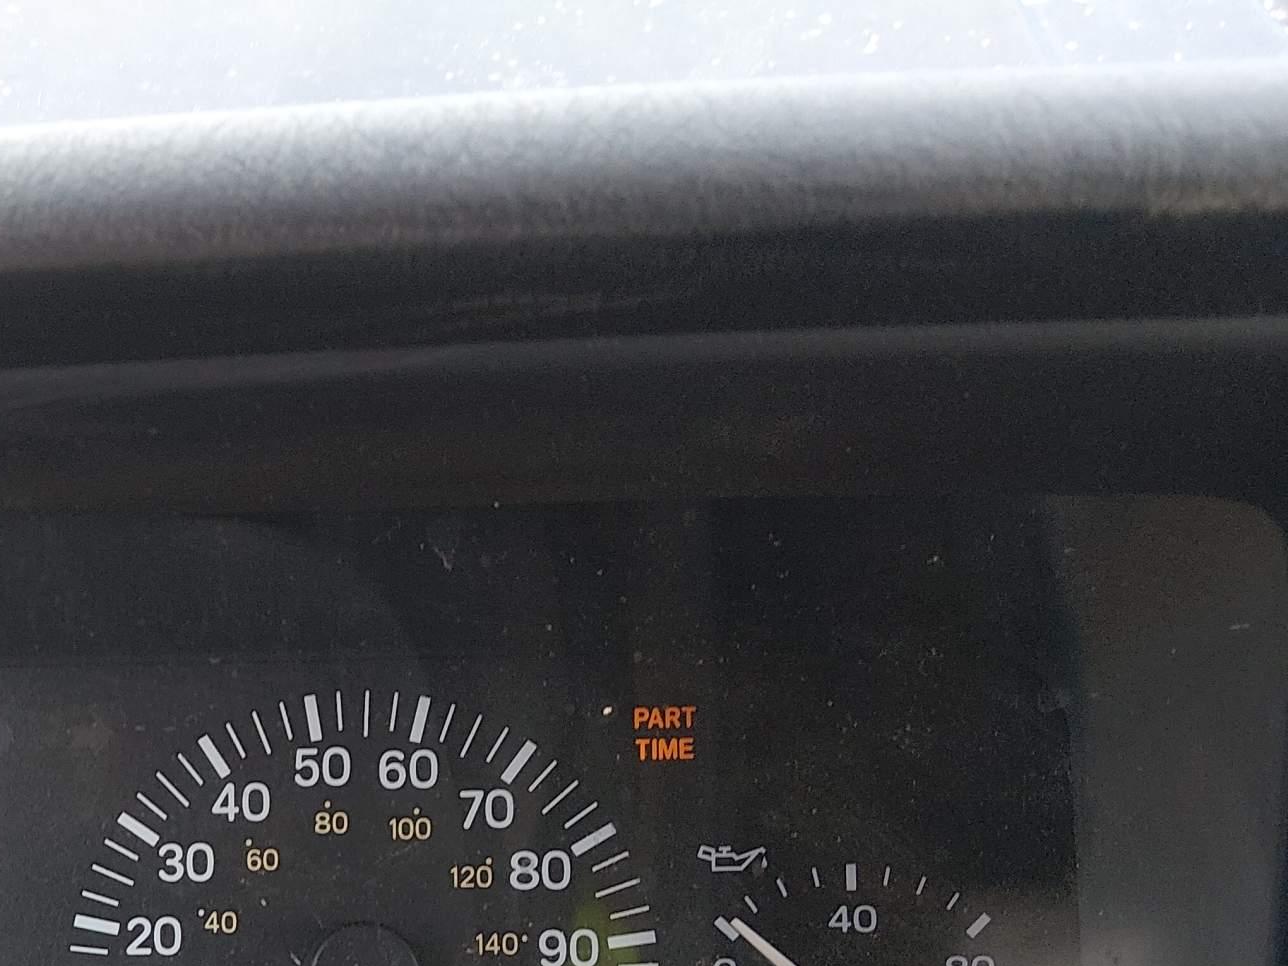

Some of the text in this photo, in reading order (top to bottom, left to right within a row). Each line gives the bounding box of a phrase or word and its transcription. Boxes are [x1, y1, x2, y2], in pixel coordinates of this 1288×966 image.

[634, 706, 696, 730] PART
[635, 738, 695, 761] TIME
[294, 747, 352, 787] 50
[378, 749, 438, 789] 60
[211, 783, 271, 823] 40
[459, 789, 514, 829] 70
[314, 811, 349, 835] 80
[389, 816, 432, 841] 100
[157, 841, 214, 882] 30
[245, 847, 280, 872] 60
[509, 850, 572, 891] 80
[450, 865, 493, 888] 120
[204, 910, 238, 934] 40
[828, 905, 877, 933] 40
[126, 916, 183, 956] 20
[475, 933, 518, 956] 140
